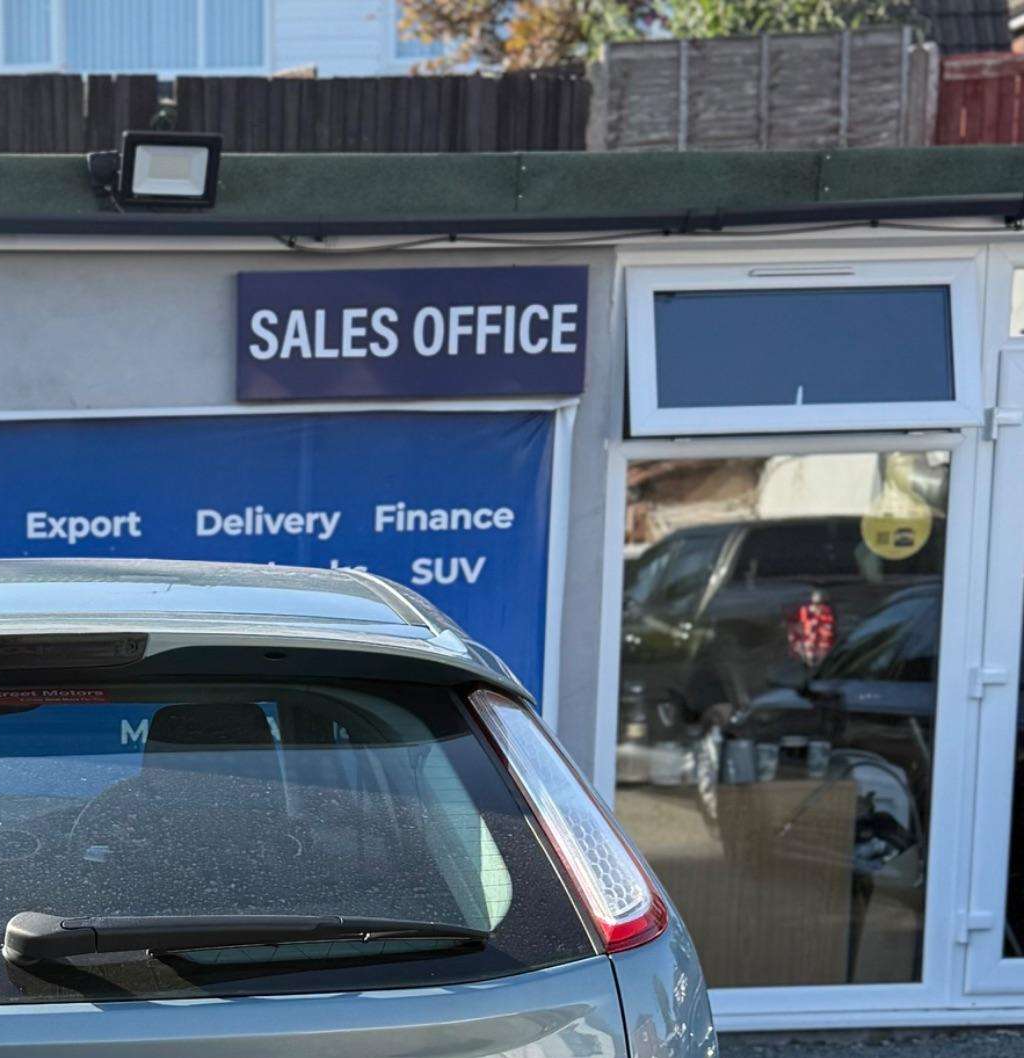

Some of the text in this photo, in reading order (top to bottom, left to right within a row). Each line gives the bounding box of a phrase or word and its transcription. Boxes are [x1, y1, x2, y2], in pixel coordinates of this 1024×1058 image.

[249, 303, 578, 360] SALES OFFICE
[26, 502, 516, 544] Export Delivery Finance
[411, 556, 487, 586] SUV
